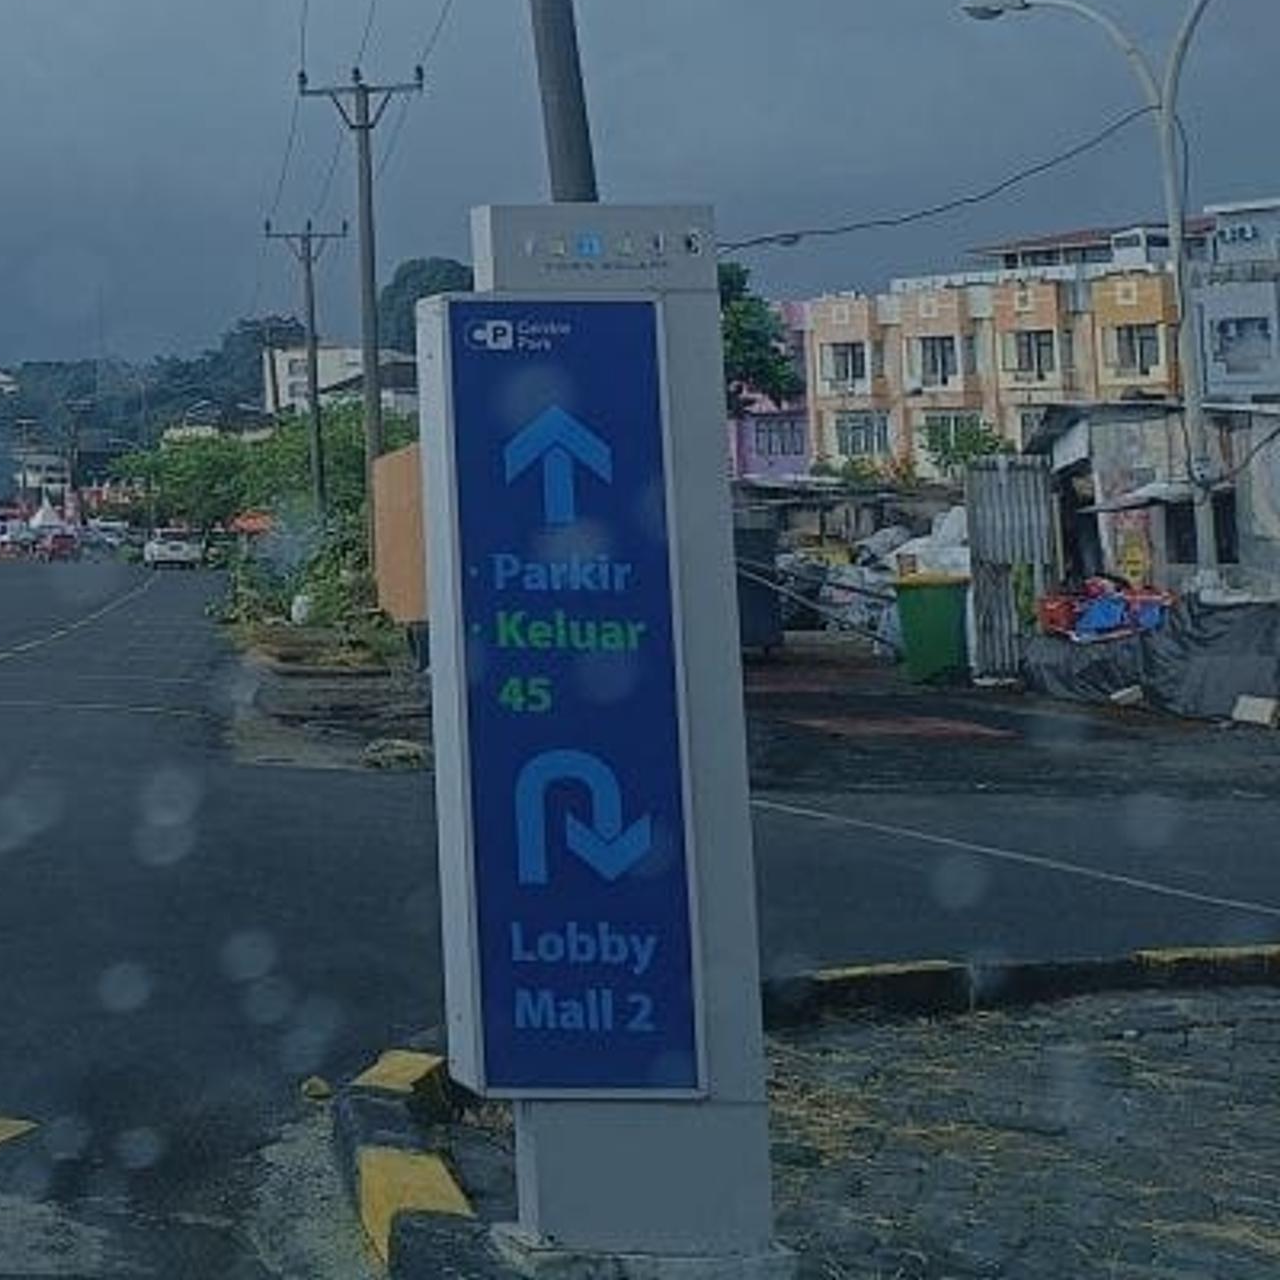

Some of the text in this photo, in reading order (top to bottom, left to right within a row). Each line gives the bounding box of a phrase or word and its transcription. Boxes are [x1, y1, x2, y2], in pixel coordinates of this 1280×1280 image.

[490, 553, 632, 590] Parkir
[496, 610, 645, 650] Keluar
[499, 676, 553, 712] 45
[511, 920, 657, 974] Lobby
[514, 988, 656, 1032] Mall 2
